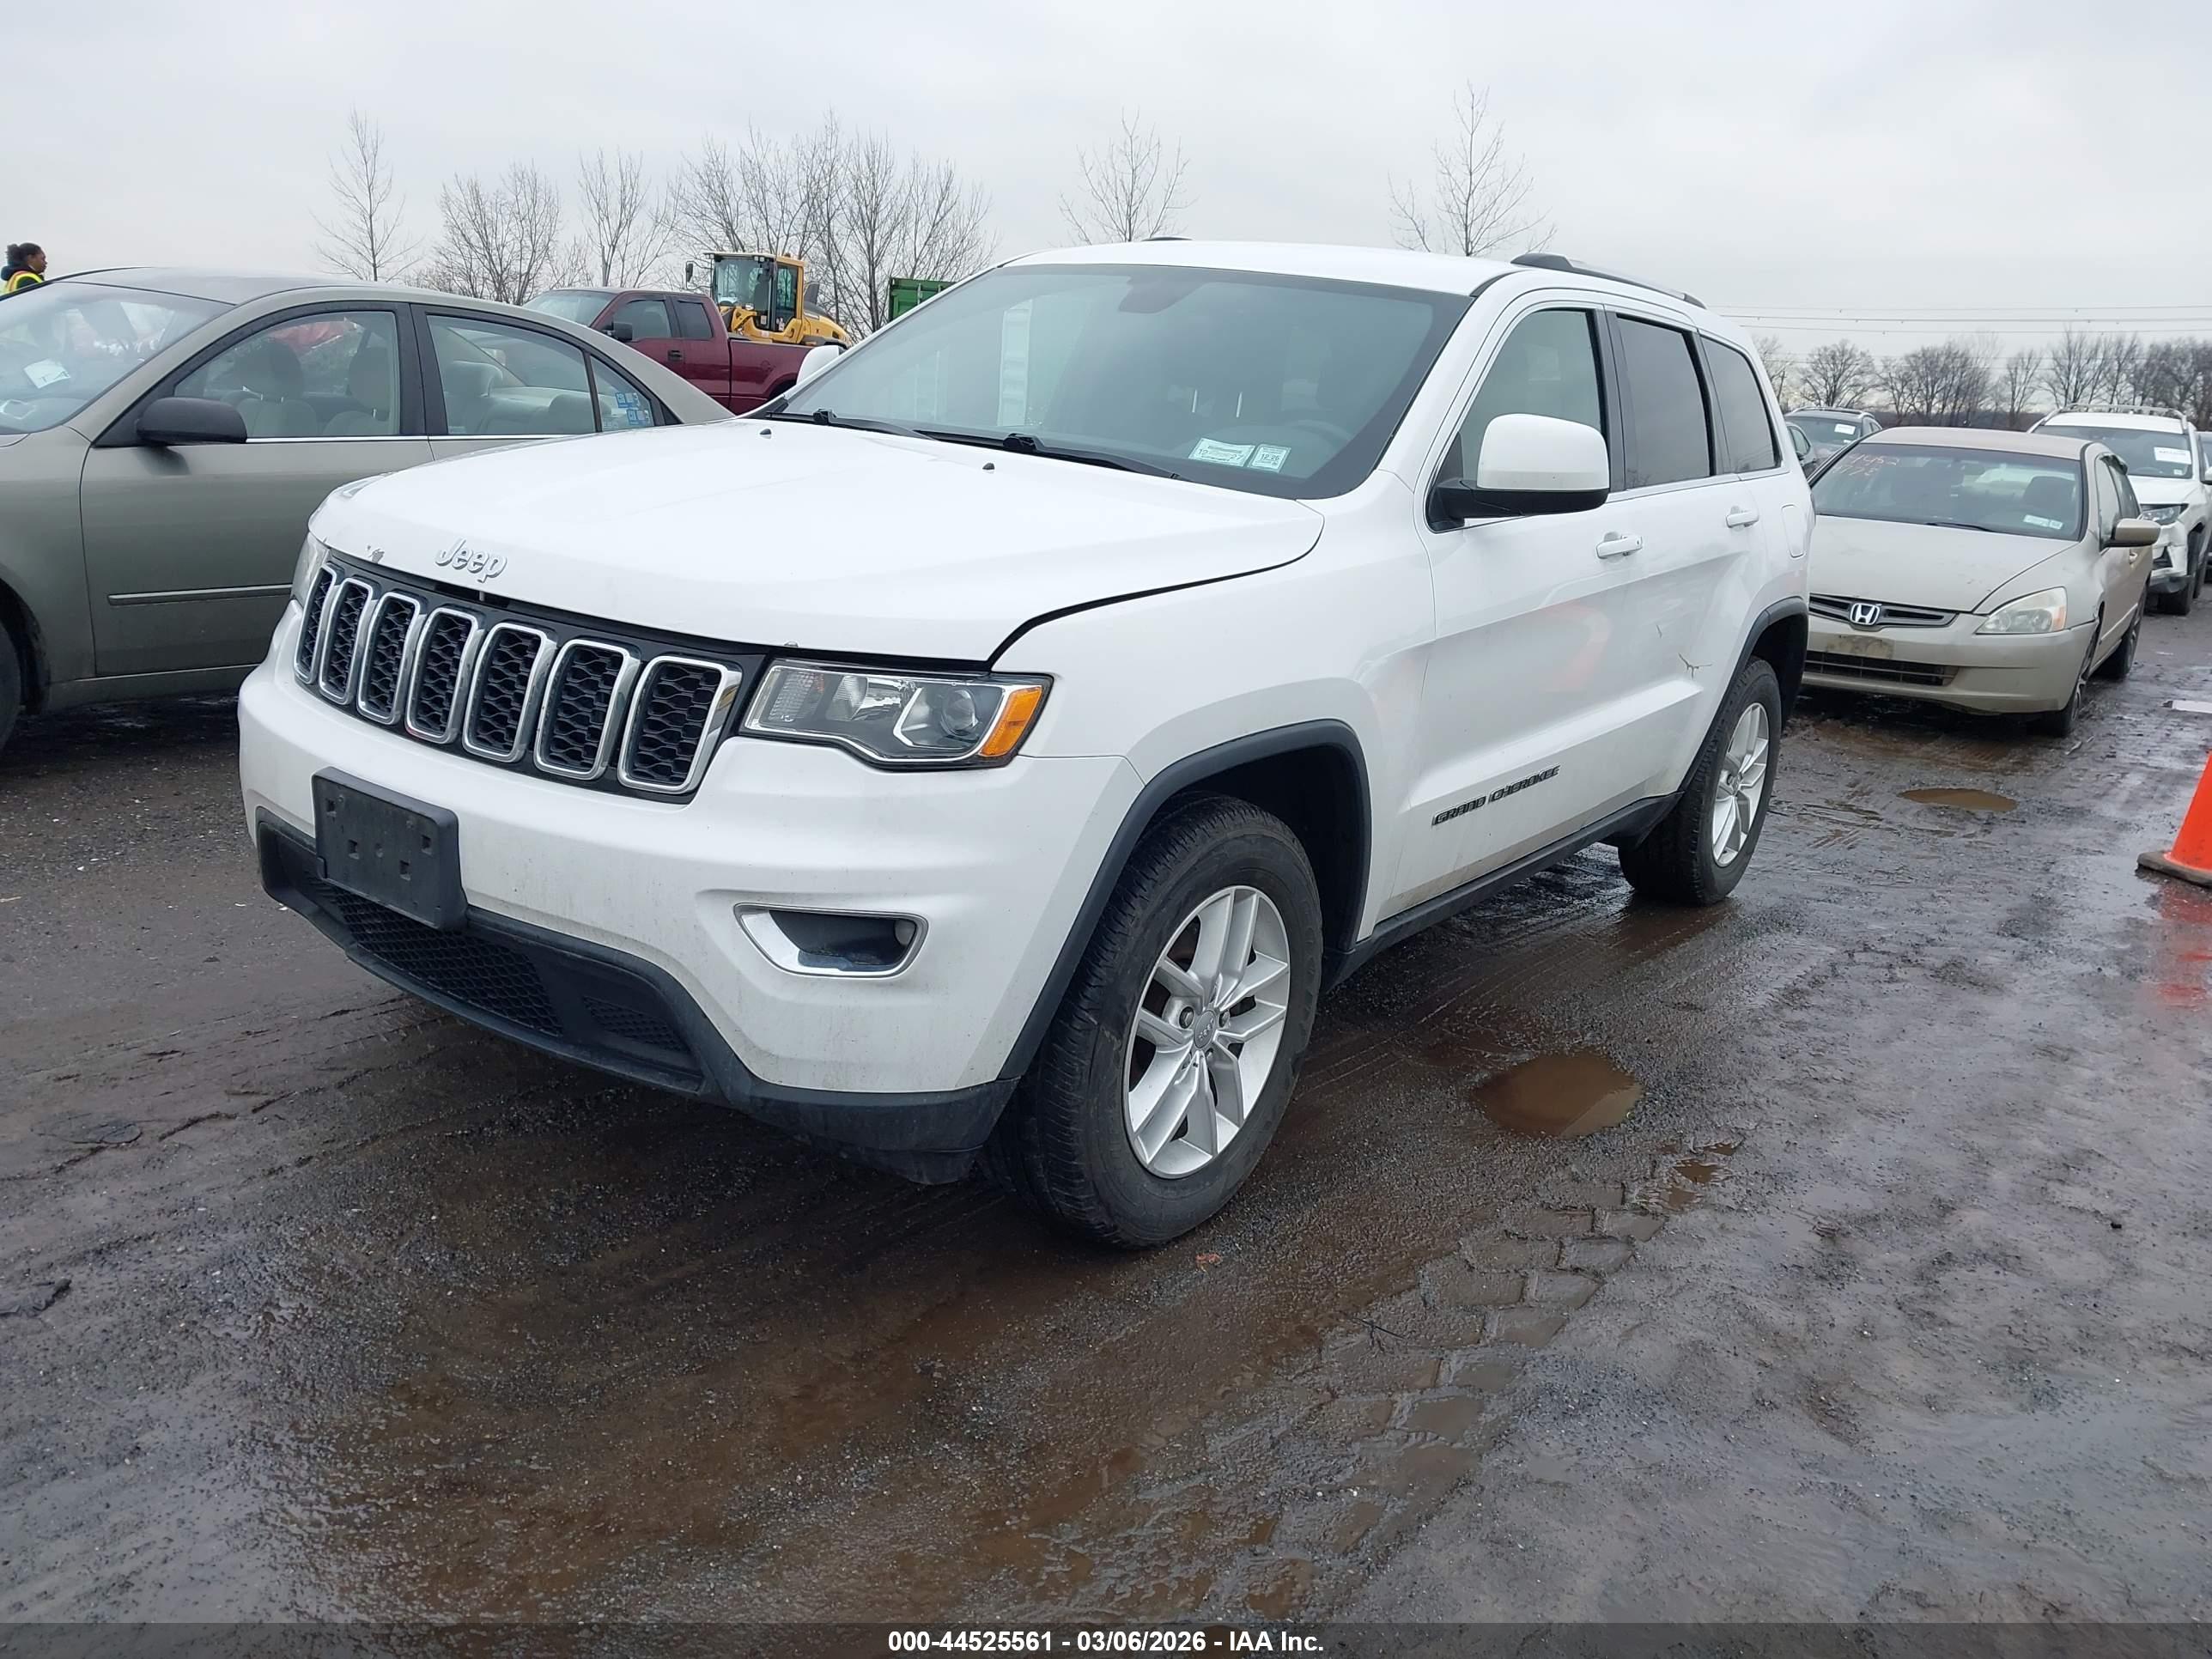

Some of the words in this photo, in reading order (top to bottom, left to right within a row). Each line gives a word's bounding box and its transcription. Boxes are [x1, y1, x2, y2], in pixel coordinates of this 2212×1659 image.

[435, 536, 507, 584] Jeep
[1431, 795, 1487, 826] GRAND
[1488, 763, 1561, 804] CHEROKEE
